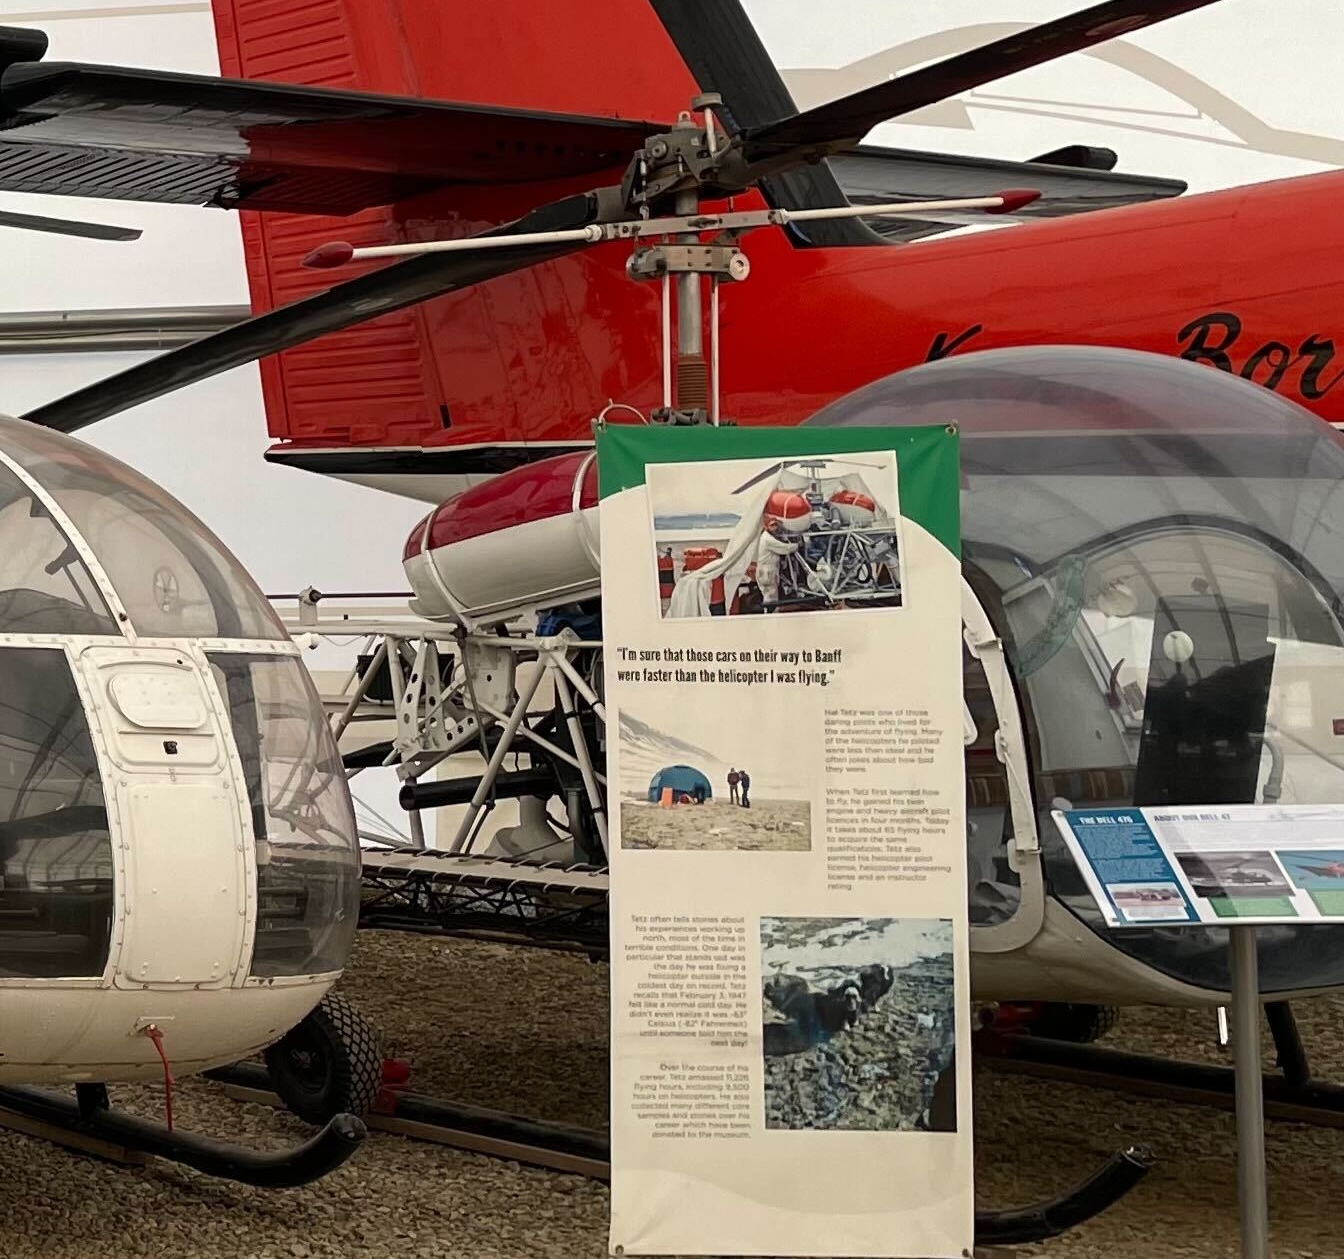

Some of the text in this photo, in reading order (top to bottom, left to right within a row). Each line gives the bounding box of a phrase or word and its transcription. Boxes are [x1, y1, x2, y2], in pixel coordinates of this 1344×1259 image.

[1177, 312, 1344, 400] Bor
[639, 650, 661, 662] sure
[664, 648, 684, 662] that
[686, 648, 713, 662] those
[716, 651, 737, 662] cars
[740, 652, 752, 662] on
[754, 648, 778, 663] their
[780, 651, 800, 665] way
[802, 650, 812, 663] to
[815, 650, 842, 663] Banff
[617, 670, 640, 681] were
[643, 668, 672, 682] faster
[675, 668, 697, 682] than
[700, 669, 716, 682] the
[718, 669, 768, 686] helicopter
[776, 672, 796, 684] was
